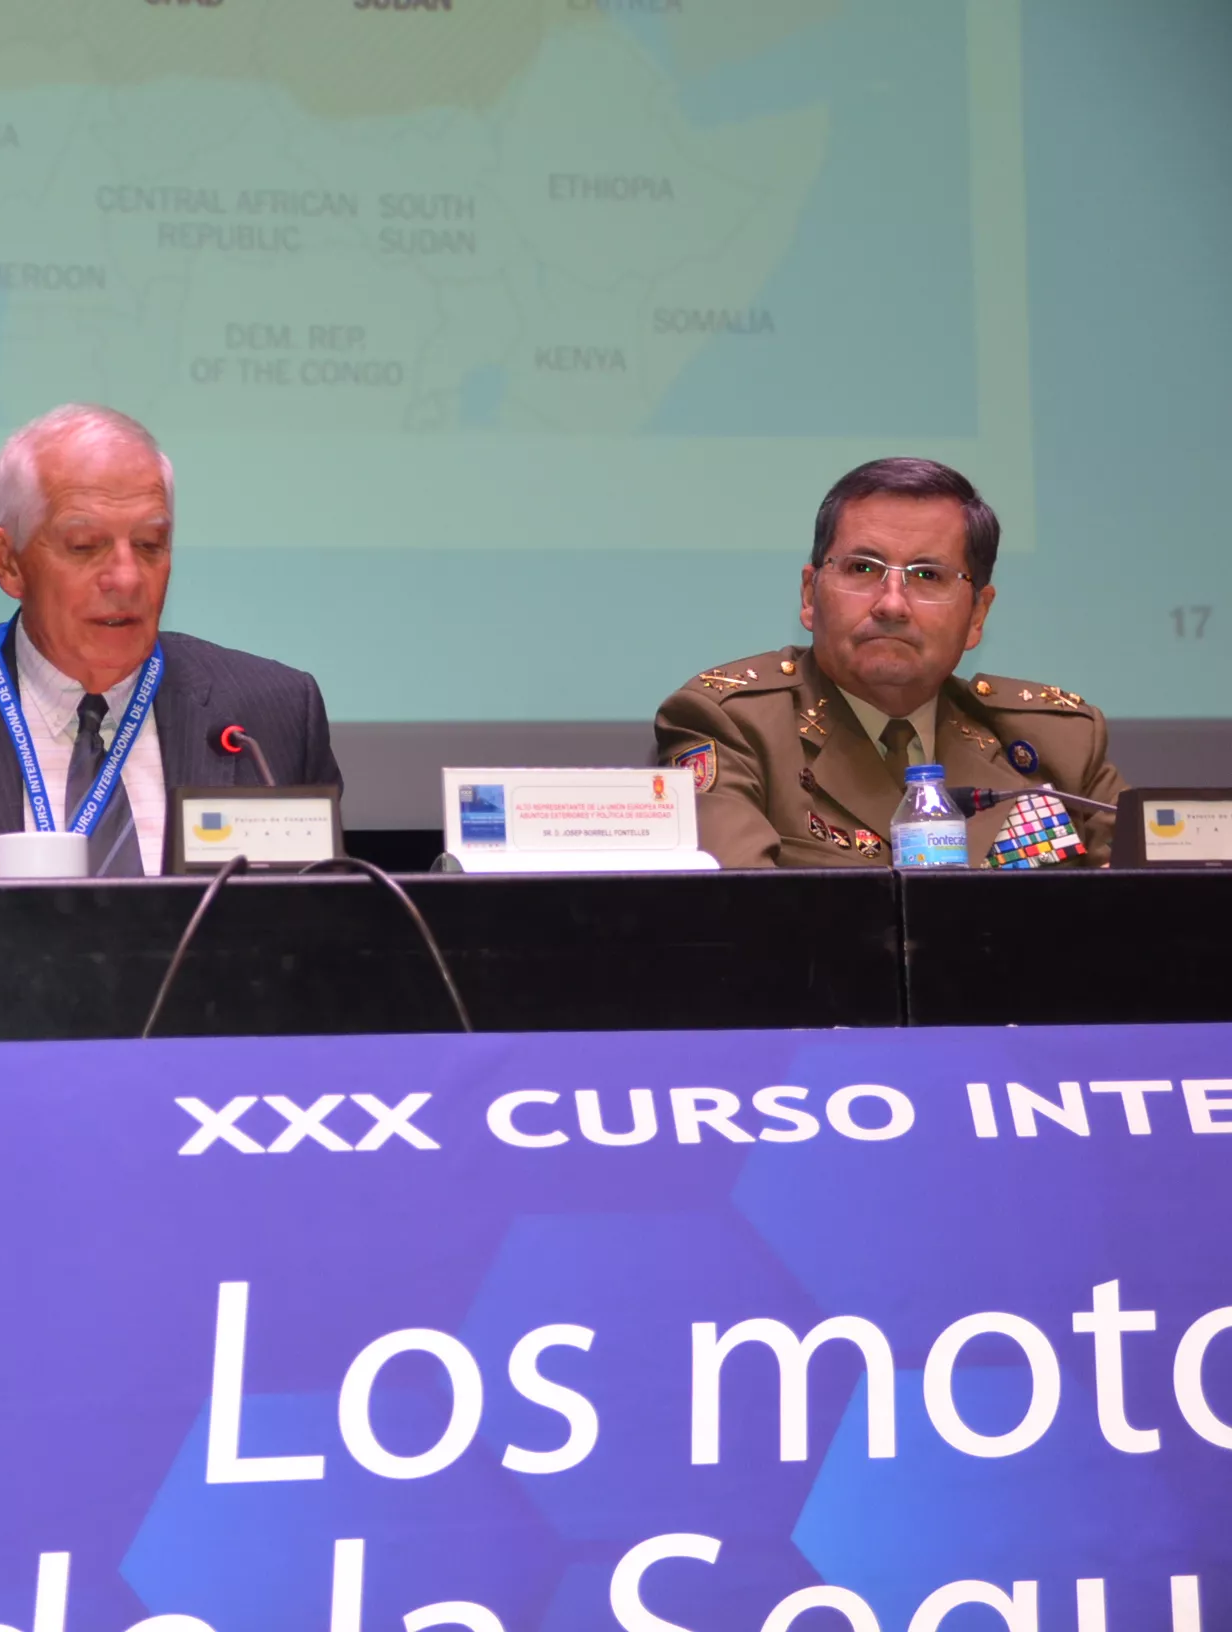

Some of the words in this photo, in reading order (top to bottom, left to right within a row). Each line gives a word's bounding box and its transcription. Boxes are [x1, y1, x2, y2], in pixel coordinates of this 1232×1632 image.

[94, 184, 228, 215] CENTRAL
[235, 187, 360, 218] AFRICAN
[548, 172, 675, 201] ETHIOPIA
[378, 192, 477, 221] SOUTH
[156, 220, 303, 252] REPUBLIC
[377, 226, 478, 255] SUDAN
[653, 306, 776, 335] SOMALIA
[189, 356, 227, 384] OF
[236, 357, 293, 386] THE
[299, 358, 405, 388] CONGO
[534, 345, 627, 373] KENYA
[1168, 605, 1213, 640] 17
[136, 656, 161, 704] DEFENSA
[130, 703, 144, 720] DE
[4, 702, 41, 793] INTERNACIONAL
[92, 721, 137, 802] INTERNACIONAL
[33, 796, 51, 832] URSO
[174, 1092, 442, 1156] XXX
[484, 1083, 917, 1149] CURSO
[965, 1078, 1232, 1139] INTE
[205, 1280, 599, 1485] Los
